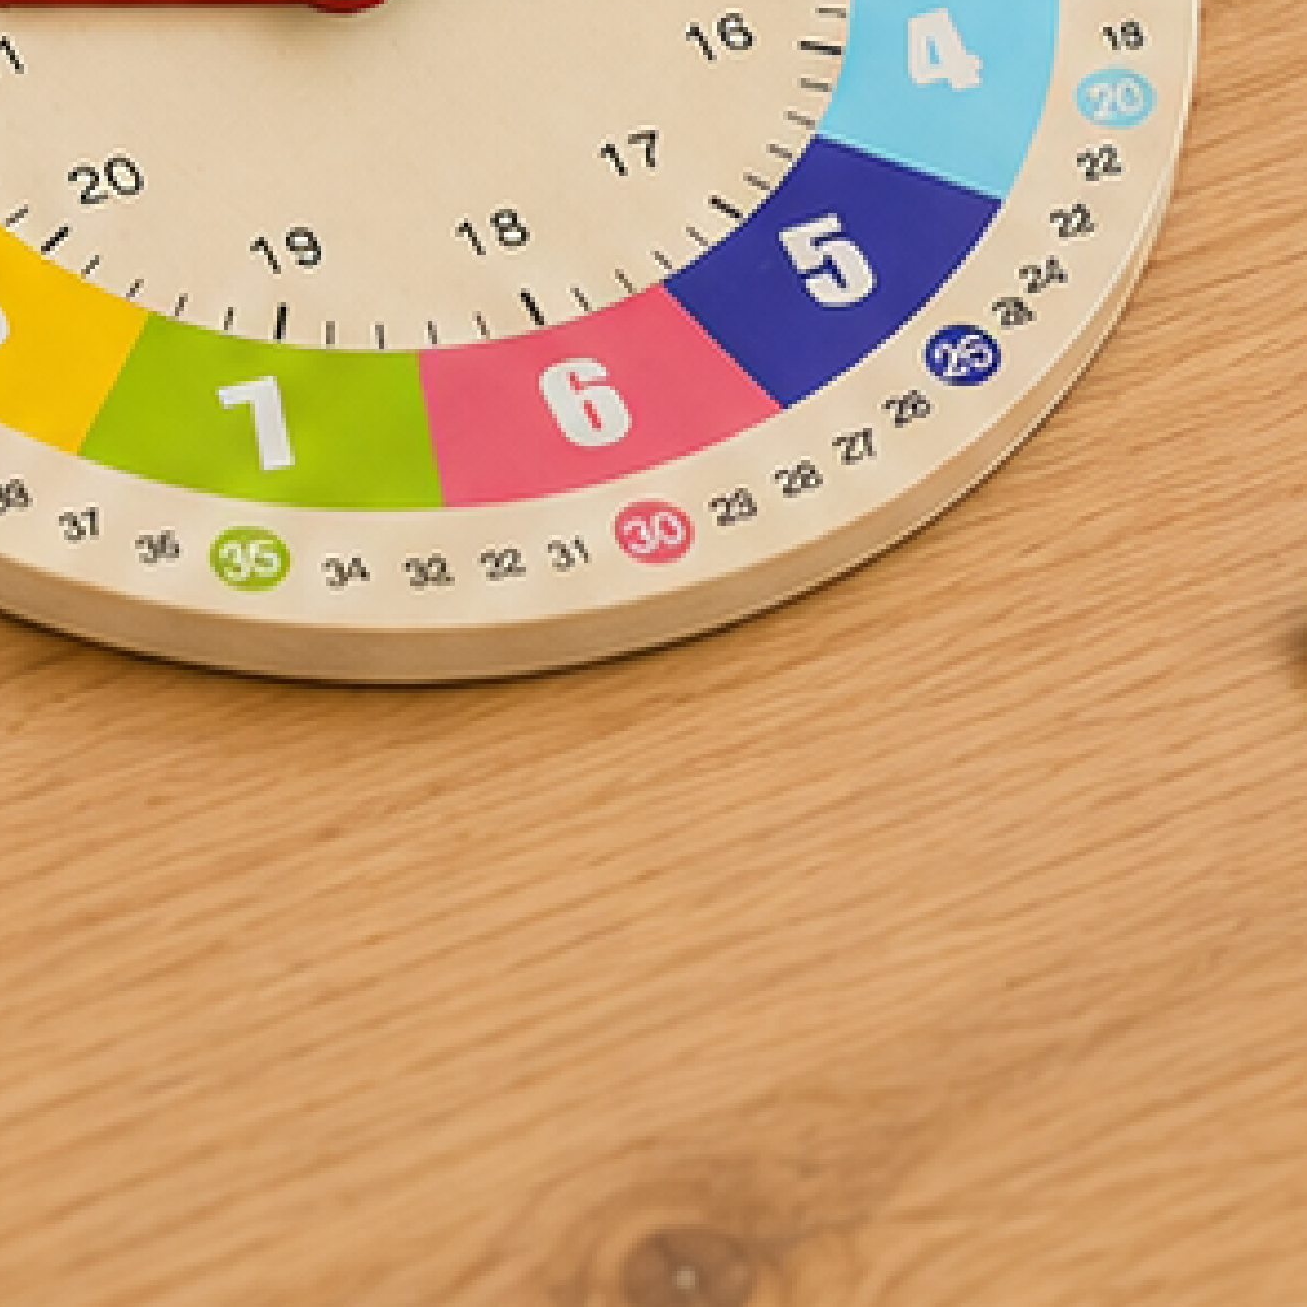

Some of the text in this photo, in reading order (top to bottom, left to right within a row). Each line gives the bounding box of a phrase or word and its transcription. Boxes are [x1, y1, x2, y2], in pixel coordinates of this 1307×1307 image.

[685, 12, 753, 61] 16
[908, 8, 983, 92] 4
[600, 129, 656, 177] 17
[67, 157, 145, 205] 20
[249, 226, 322, 275] 19
[458, 208, 531, 256] 18
[779, 213, 872, 307] 5
[219, 376, 295, 470] 7
[539, 358, 632, 446] 6
[623, 511, 688, 553] 30
[218, 538, 280, 582] 35
